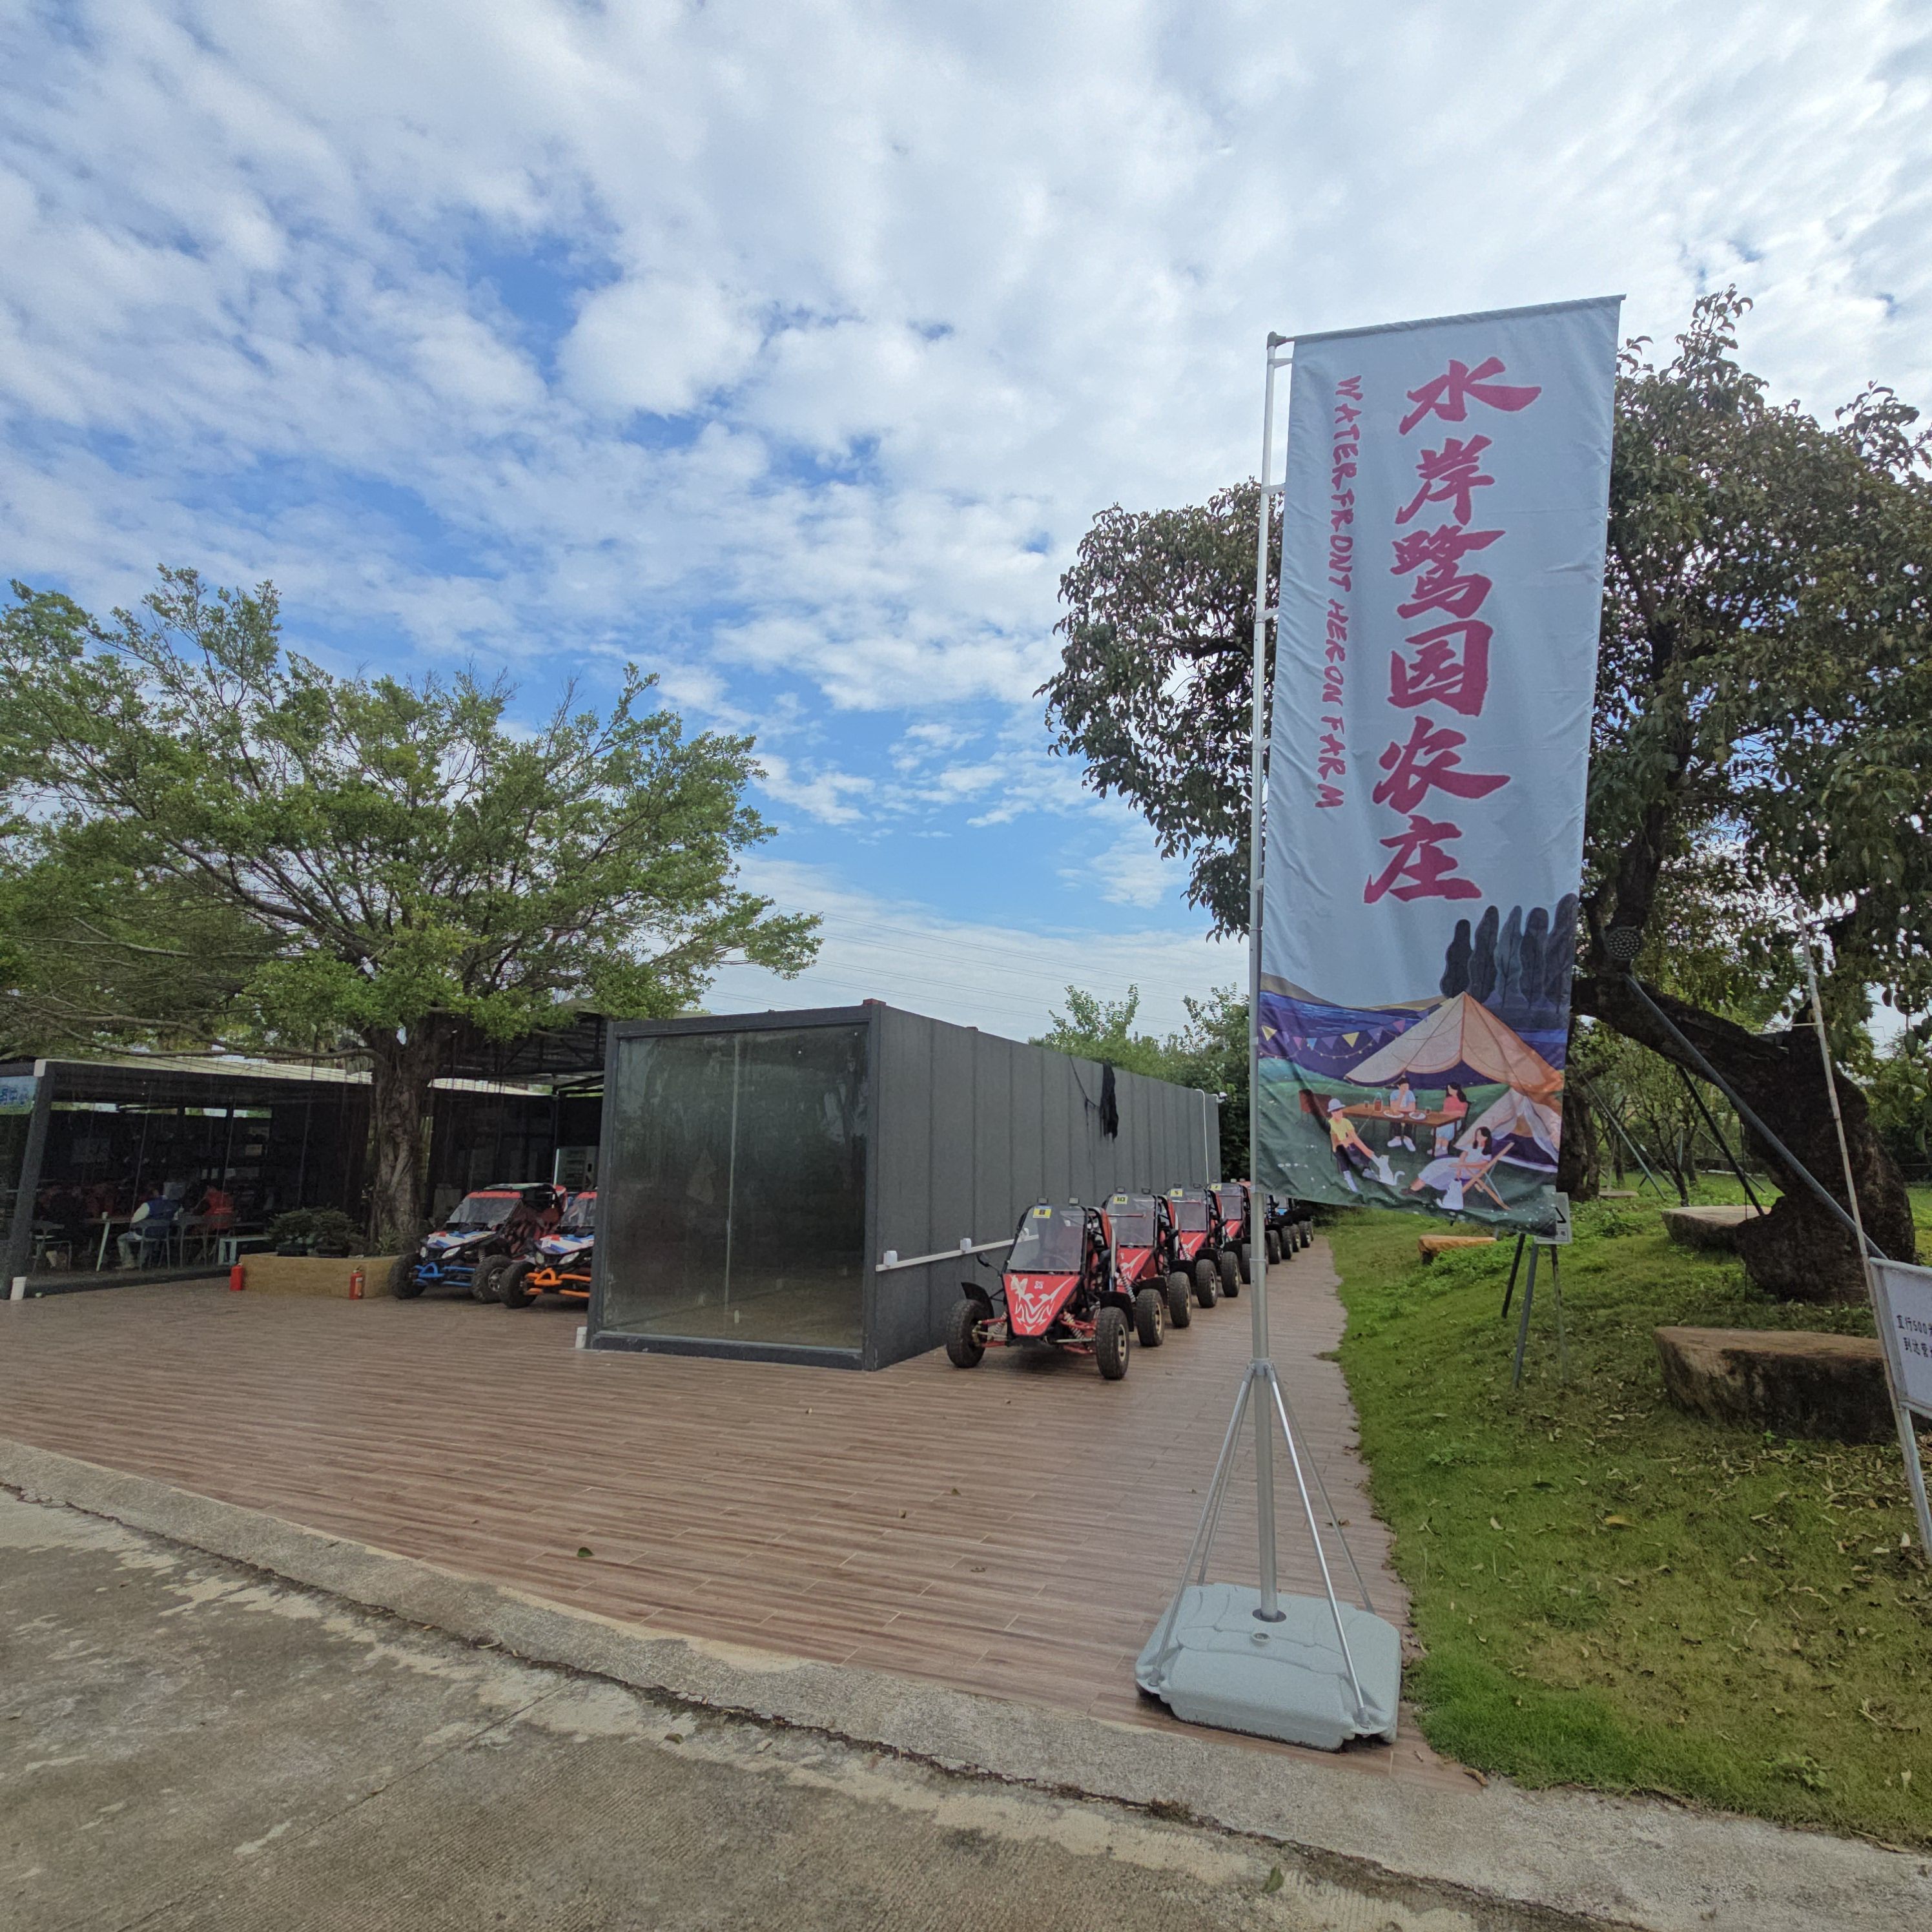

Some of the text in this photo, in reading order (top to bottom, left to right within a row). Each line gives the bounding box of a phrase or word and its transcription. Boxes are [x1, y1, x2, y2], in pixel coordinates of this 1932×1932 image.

[1315, 375, 1363, 808] WATERFRONT HERON FARM
[1364, 356, 1541, 904] 水岸鹭园农庄
